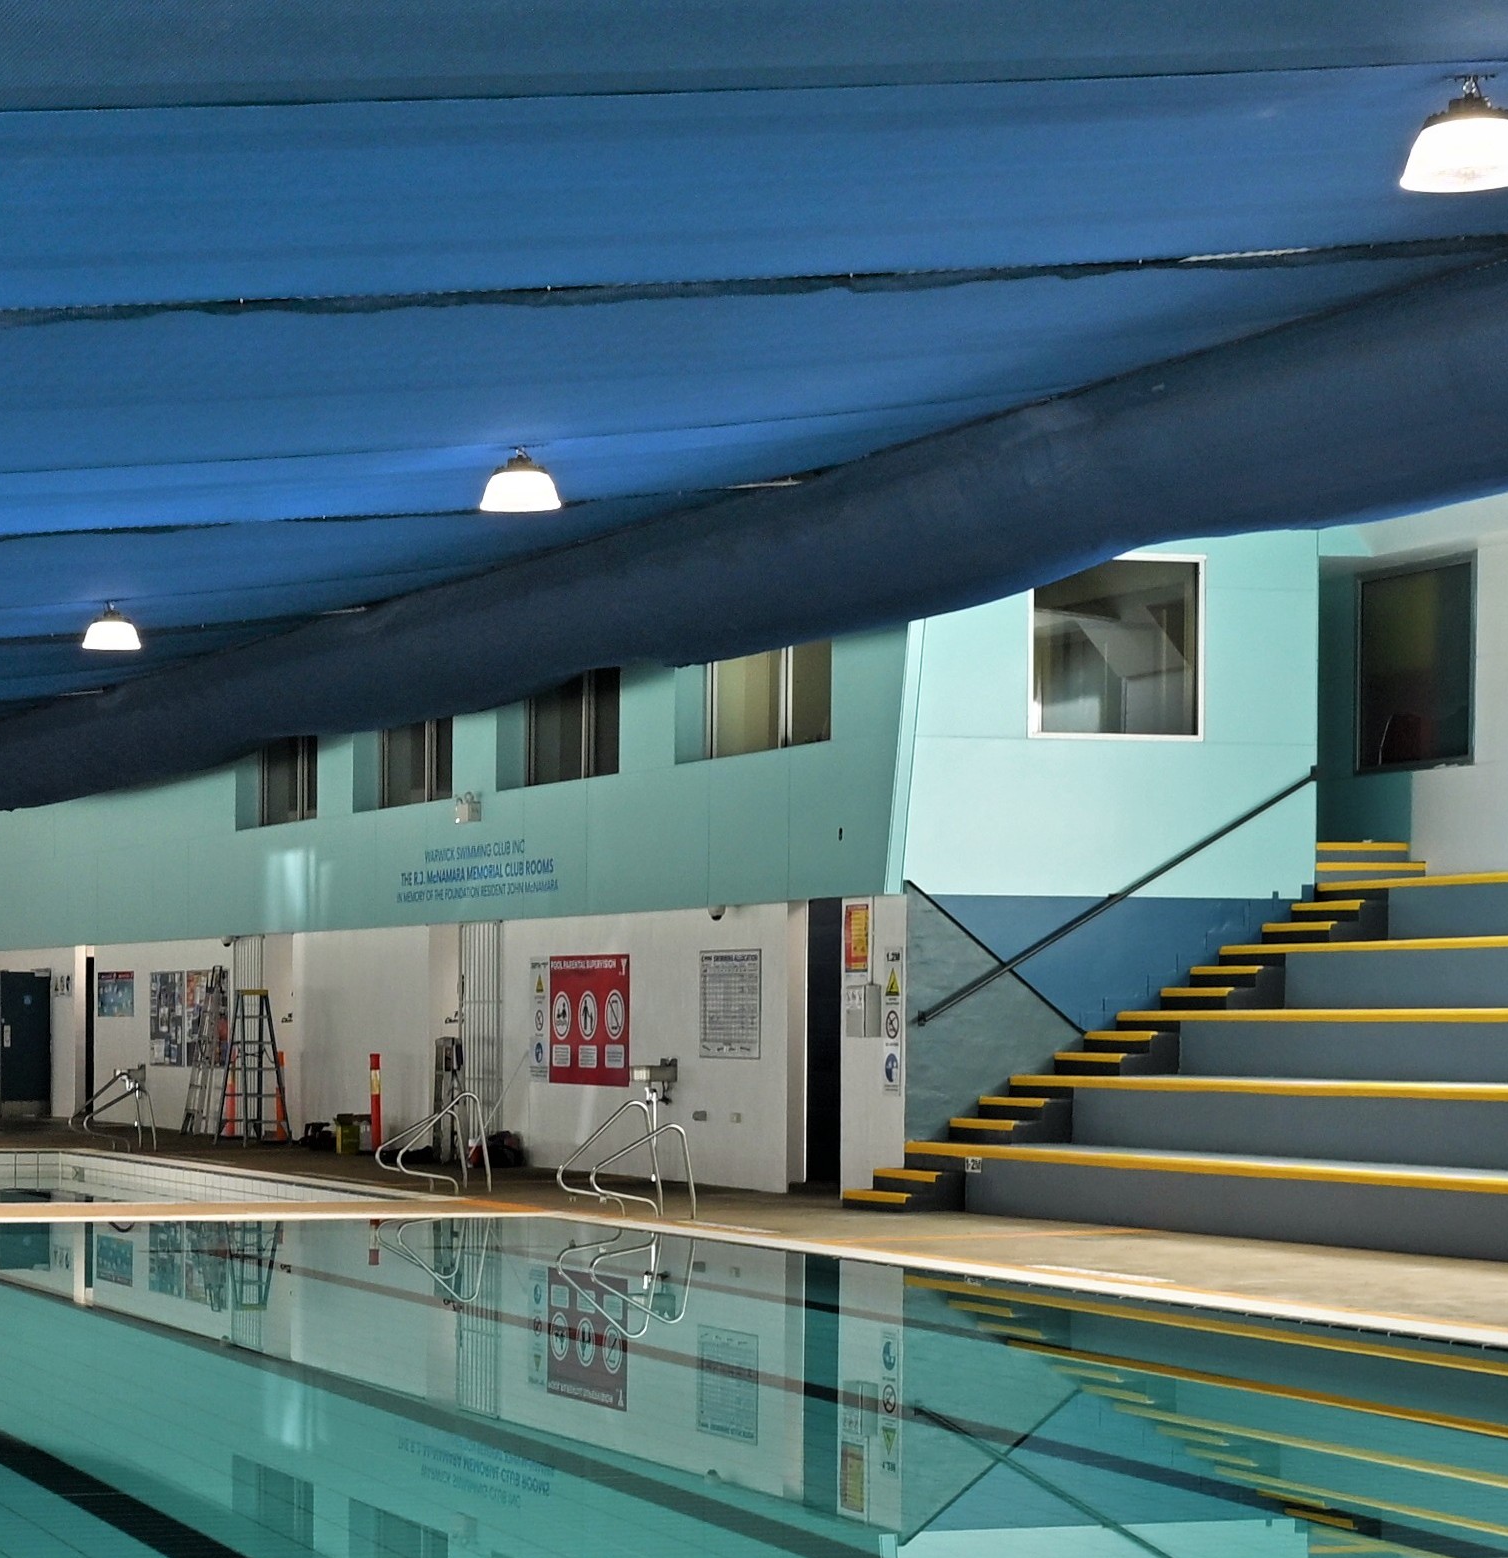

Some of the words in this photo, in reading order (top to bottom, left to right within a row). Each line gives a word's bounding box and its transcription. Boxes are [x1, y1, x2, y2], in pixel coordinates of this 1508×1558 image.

[425, 849, 455, 863] WARWICK
[456, 845, 492, 860] SWIMMING
[493, 841, 511, 855] CLUB
[512, 839, 525, 853] INC
[401, 872, 412, 886] THE
[426, 867, 465, 884] McNAMARA
[466, 862, 504, 880] MEMORIAL
[505, 861, 524, 877] CLUB
[525, 858, 554, 875] ROOMS
